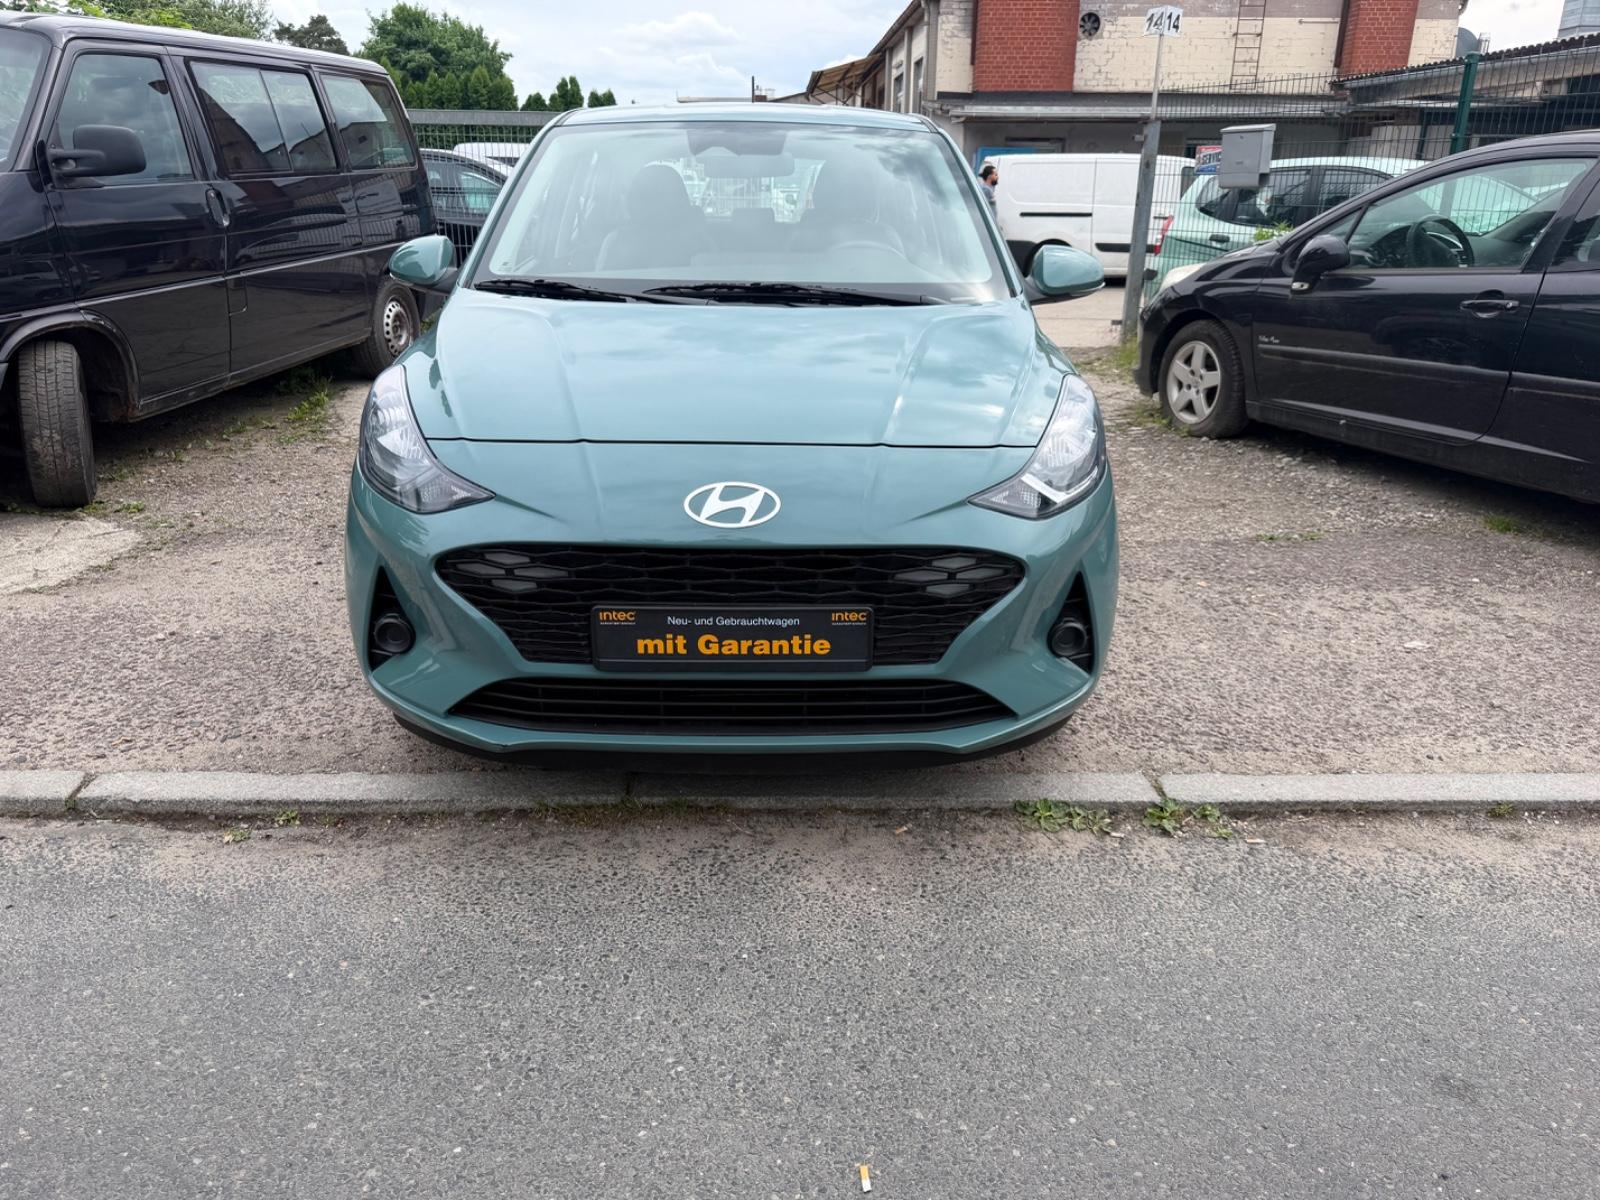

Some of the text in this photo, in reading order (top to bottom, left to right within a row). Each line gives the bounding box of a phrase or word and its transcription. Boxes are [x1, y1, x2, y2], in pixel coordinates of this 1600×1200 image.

[1146, 11, 1164, 31] 14
[1167, 11, 1181, 33] 14
[599, 610, 636, 621] intec
[667, 615, 801, 628] Neu- und Gebrauchtwagen
[831, 610, 868, 621] intec
[636, 633, 832, 656] mit Garantie
